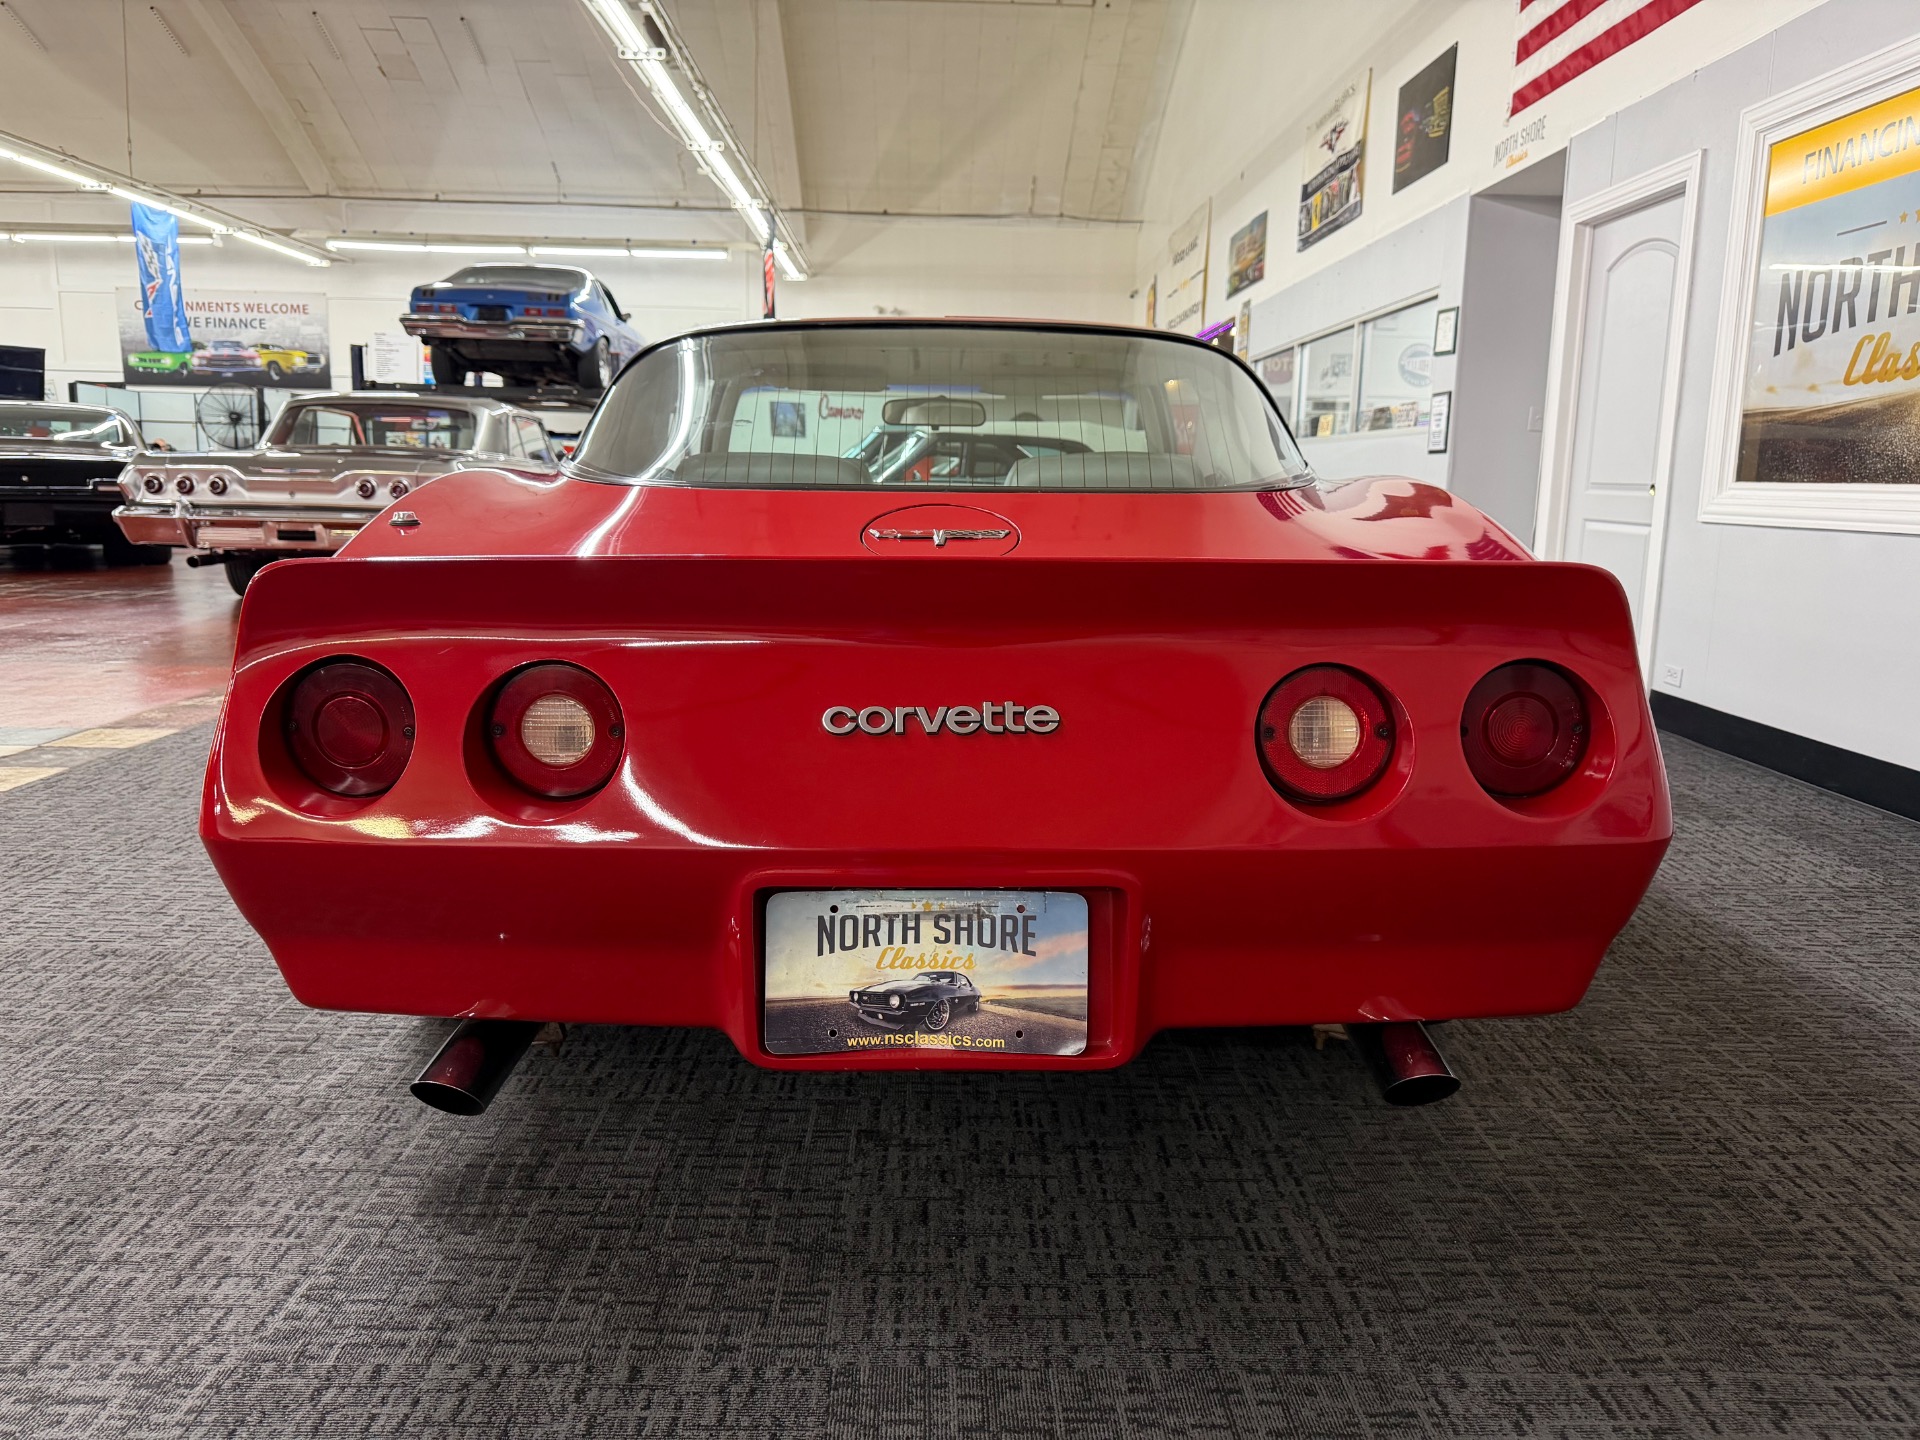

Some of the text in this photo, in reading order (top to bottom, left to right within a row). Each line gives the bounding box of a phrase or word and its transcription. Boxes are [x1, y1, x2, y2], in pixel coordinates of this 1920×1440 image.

[1493, 114, 1547, 168] NORTH SHORE
[1802, 115, 1920, 184] FINANCIN
[134, 300, 309, 315] CNMENTS WELCOME
[1773, 242, 1920, 357] NORTH
[205, 317, 267, 330] FINANCE
[822, 701, 1060, 735] corvette
[817, 913, 1037, 957] NORTH SHORE
[875, 946, 977, 970] Classics
[847, 1031, 1005, 1048] www.nsclassics.com
